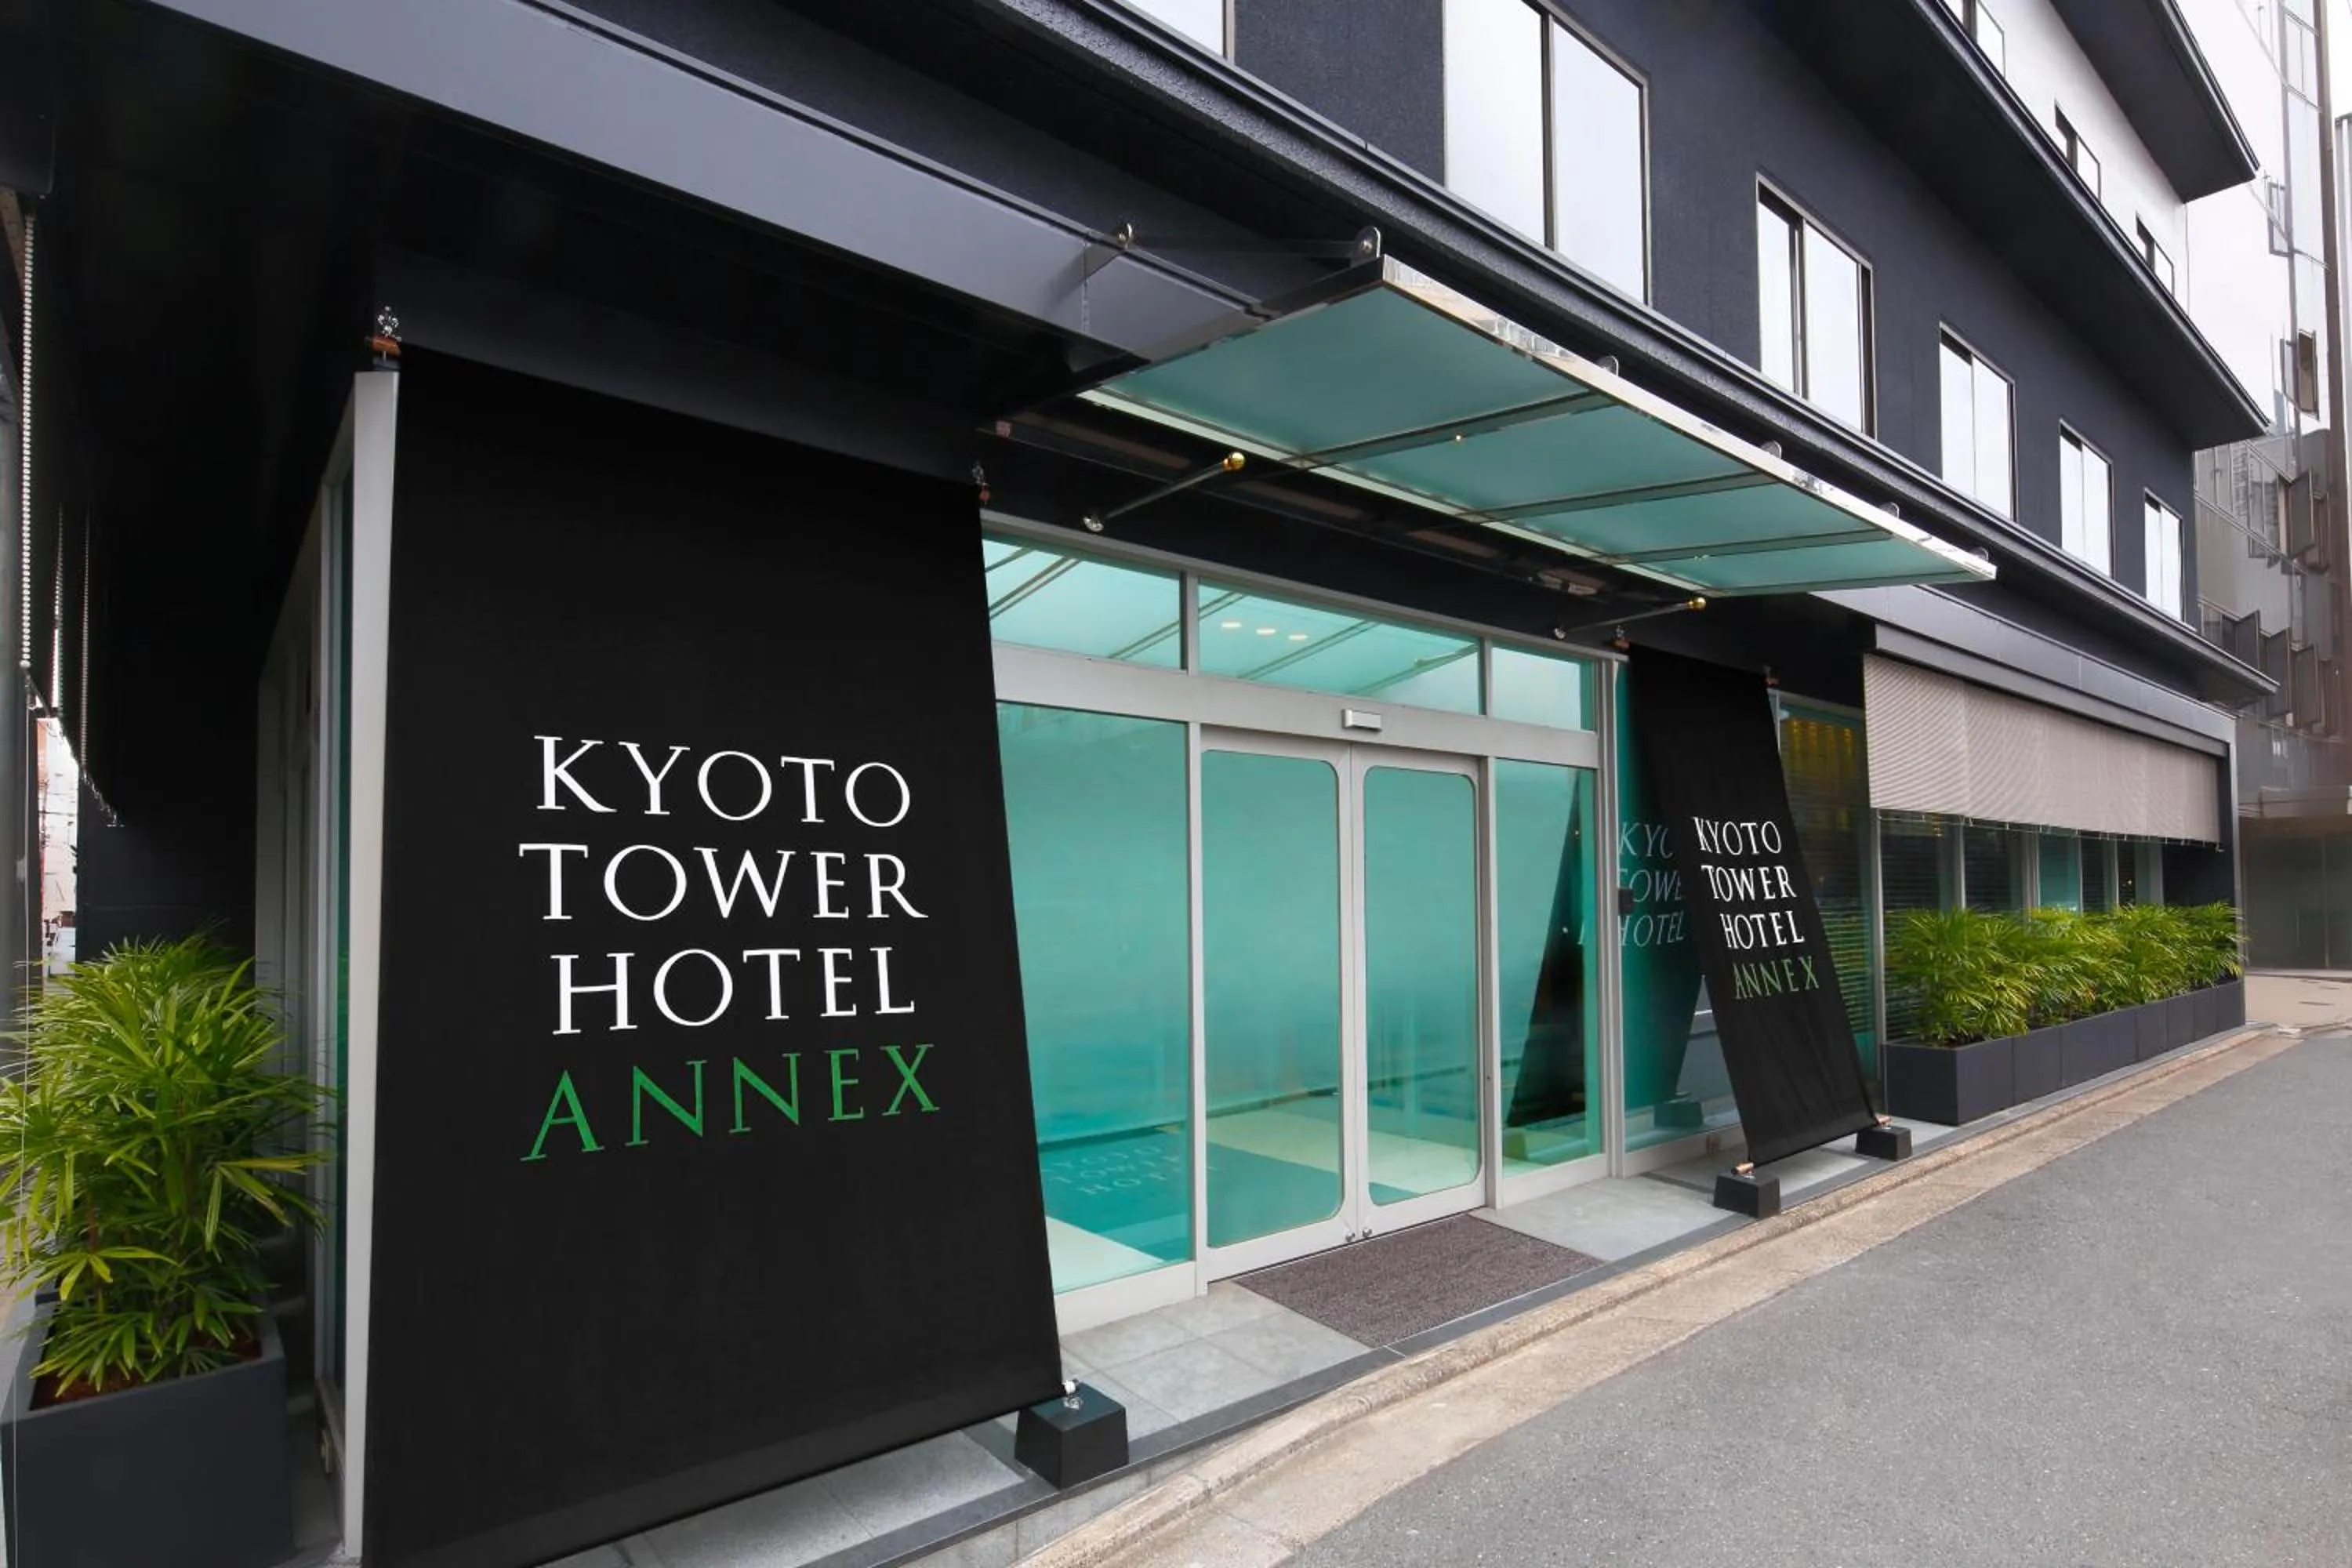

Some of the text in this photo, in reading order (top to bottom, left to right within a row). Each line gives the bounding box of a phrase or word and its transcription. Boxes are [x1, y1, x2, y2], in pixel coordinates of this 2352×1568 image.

[534, 735, 911, 827] KYOTO
[1691, 816, 1782, 855] KYOTO
[518, 843, 929, 921] TOWER
[1700, 865, 1797, 902] TOWER
[1720, 910, 1805, 949] HOTEL
[550, 947, 915, 1035] HOTEL
[1733, 956, 1820, 1000] ANNEX
[521, 1044, 939, 1160] ANNEX
